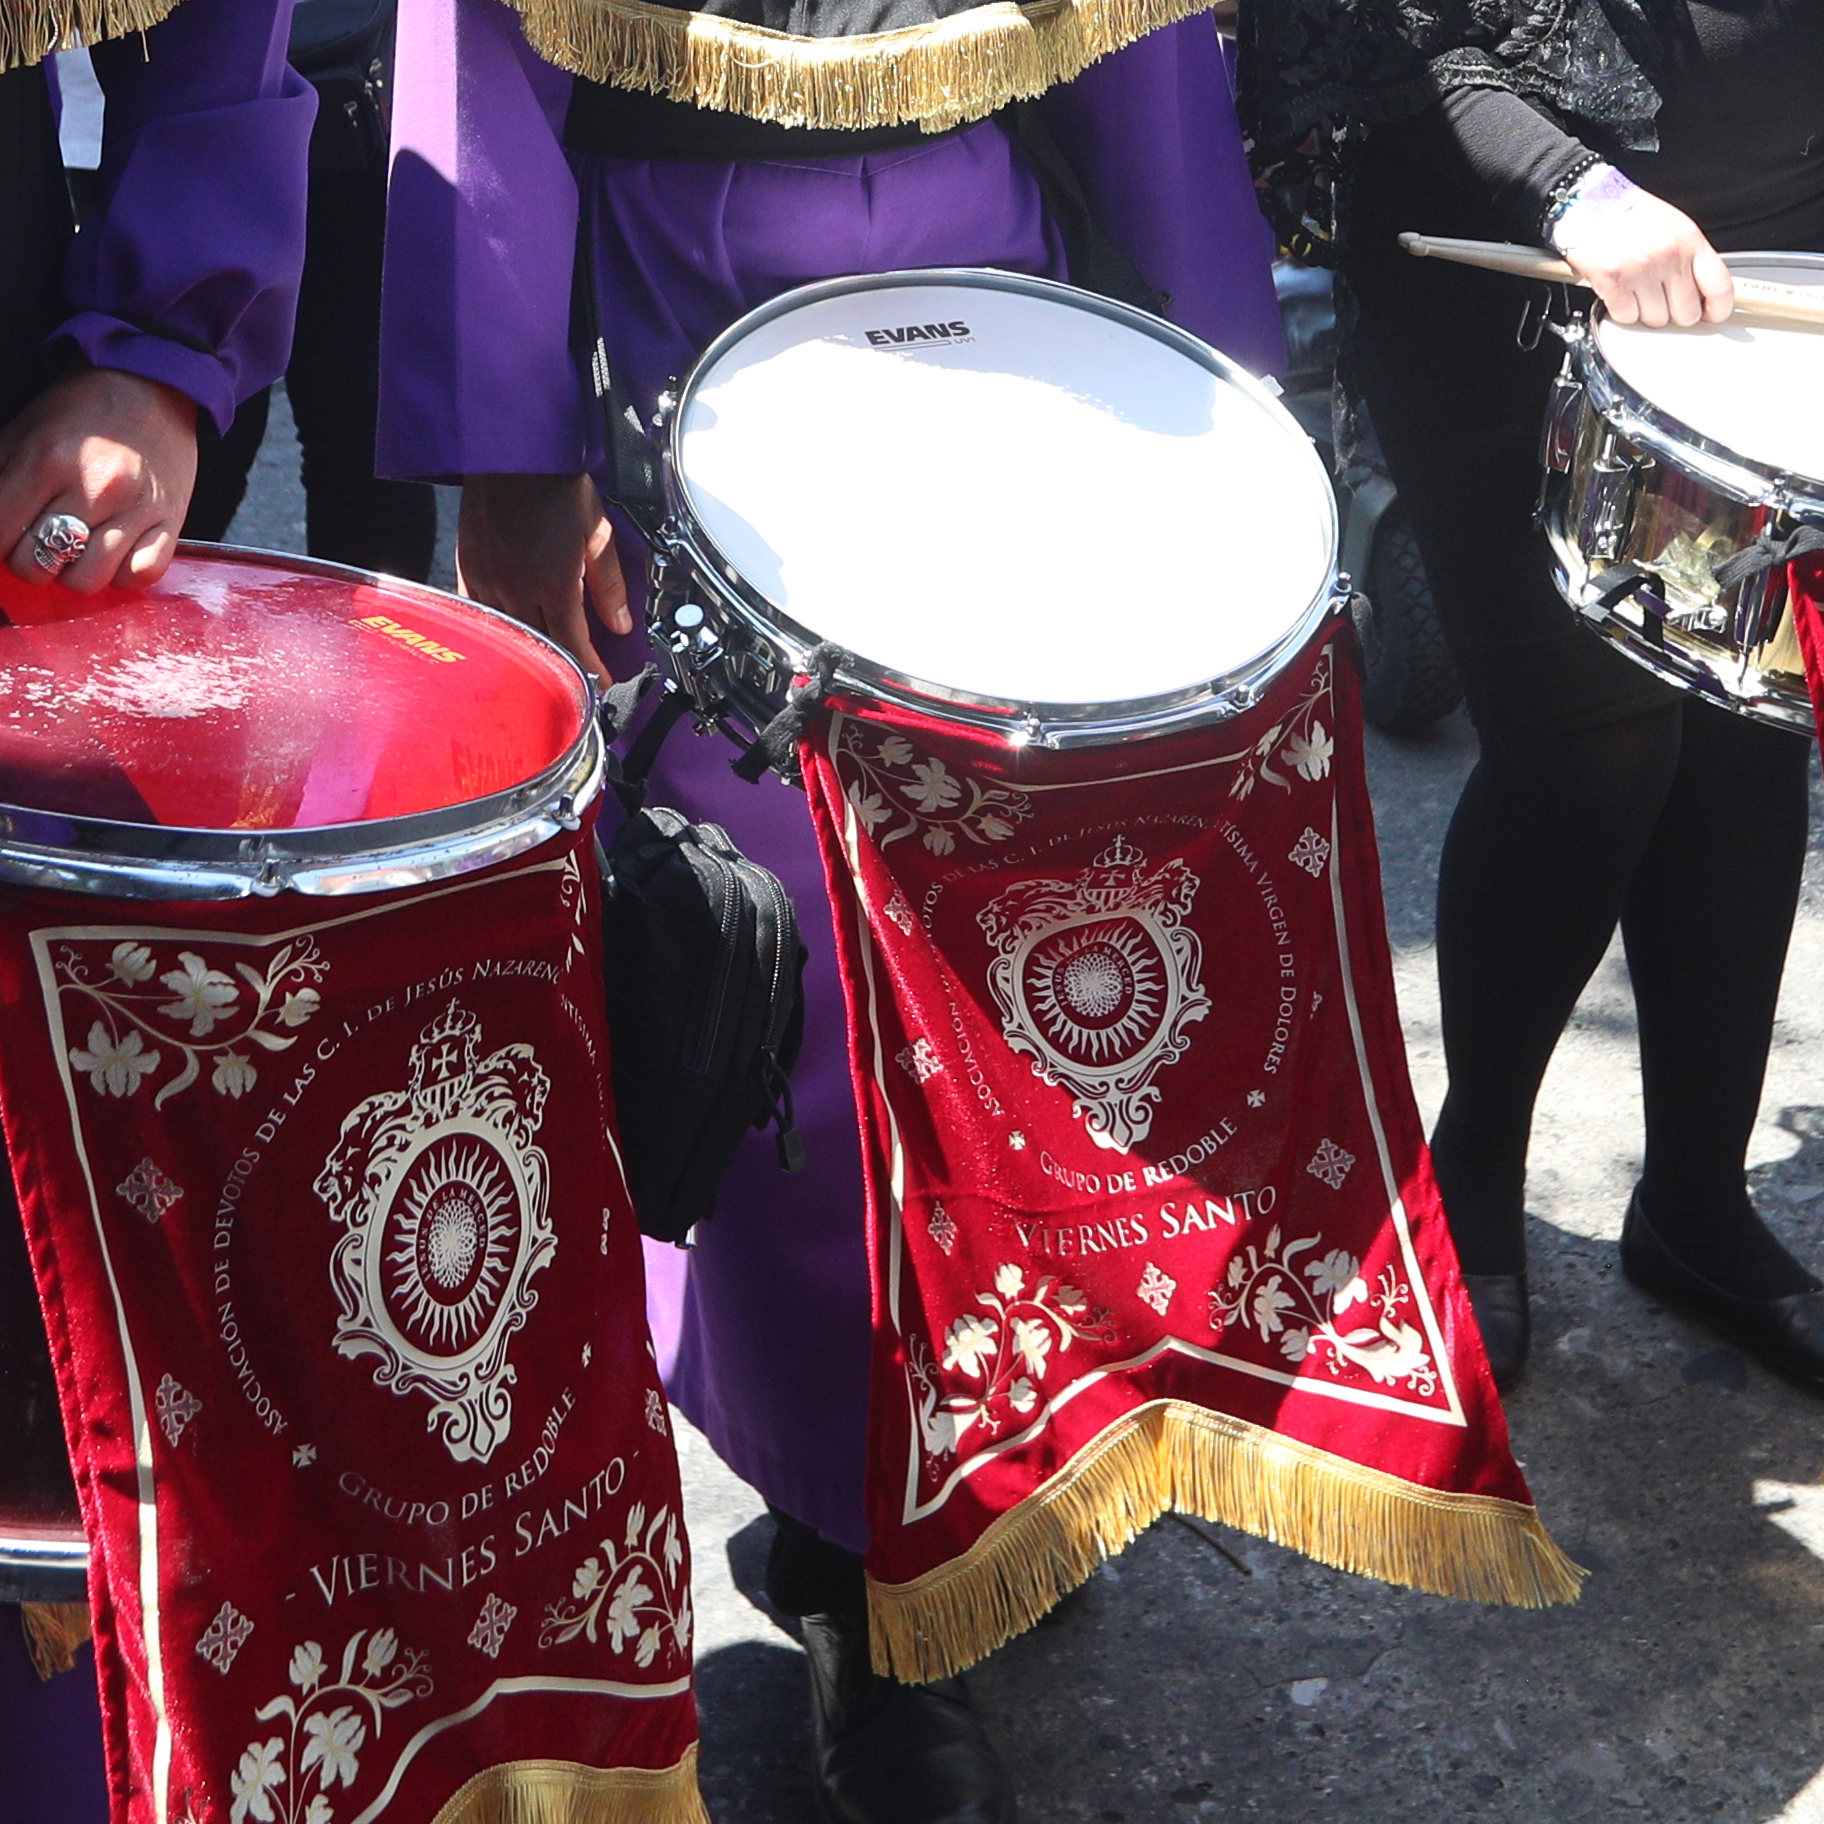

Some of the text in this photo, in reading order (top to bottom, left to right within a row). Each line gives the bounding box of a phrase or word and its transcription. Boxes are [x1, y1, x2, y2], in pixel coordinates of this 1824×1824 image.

[863, 321, 971, 346] EVANS
[361, 615, 466, 663] EVANS
[1257, 871, 1290, 946] VIRGEN
[404, 966, 464, 1008] JESÚS
[1279, 953, 1295, 978] DE
[343, 1021, 359, 1037] I.
[367, 996, 395, 1022] DE
[1263, 986, 1297, 1075] DOLORES
[316, 1038, 340, 1060] C.
[283, 1063, 316, 1106] LAS
[255, 1108, 287, 1144] DE
[1040, 1117, 1238, 1194] GRUPO DE REDOBLE
[214, 1147, 260, 1251] DEVOTOS
[1159, 1185, 1277, 1239] SANTO
[214, 1259, 231, 1294] DE
[218, 1301, 288, 1436] ASOCIACIÓN
[339, 1387, 576, 1526] GRUPO DE REDOBLE
[309, 1456, 626, 1606] VIERNES SANTO
